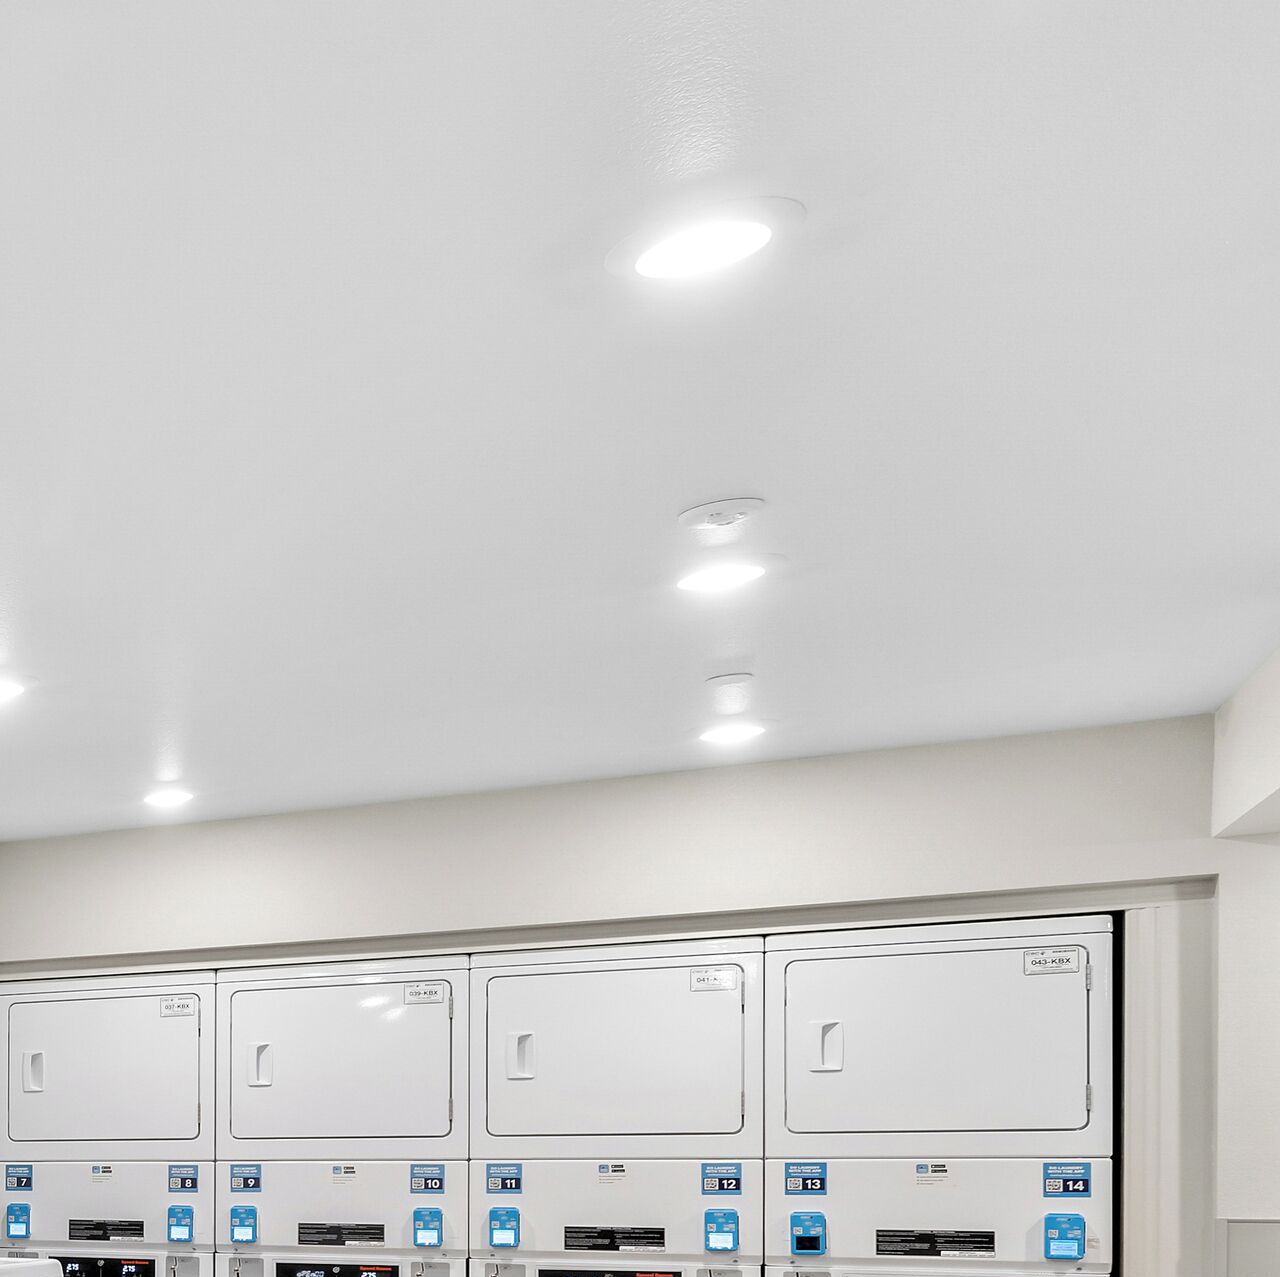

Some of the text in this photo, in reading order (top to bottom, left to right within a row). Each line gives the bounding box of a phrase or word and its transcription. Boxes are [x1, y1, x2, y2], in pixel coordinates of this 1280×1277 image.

[1031, 957, 1071, 966] 043-KBX
[185, 1179, 192, 1188] 8
[247, 1178, 255, 1187] 9
[426, 1179, 440, 1188] 10
[505, 1179, 516, 1188] 11
[721, 1180, 736, 1189] 12
[805, 1179, 821, 1189] 13
[1066, 1180, 1085, 1191] 14
